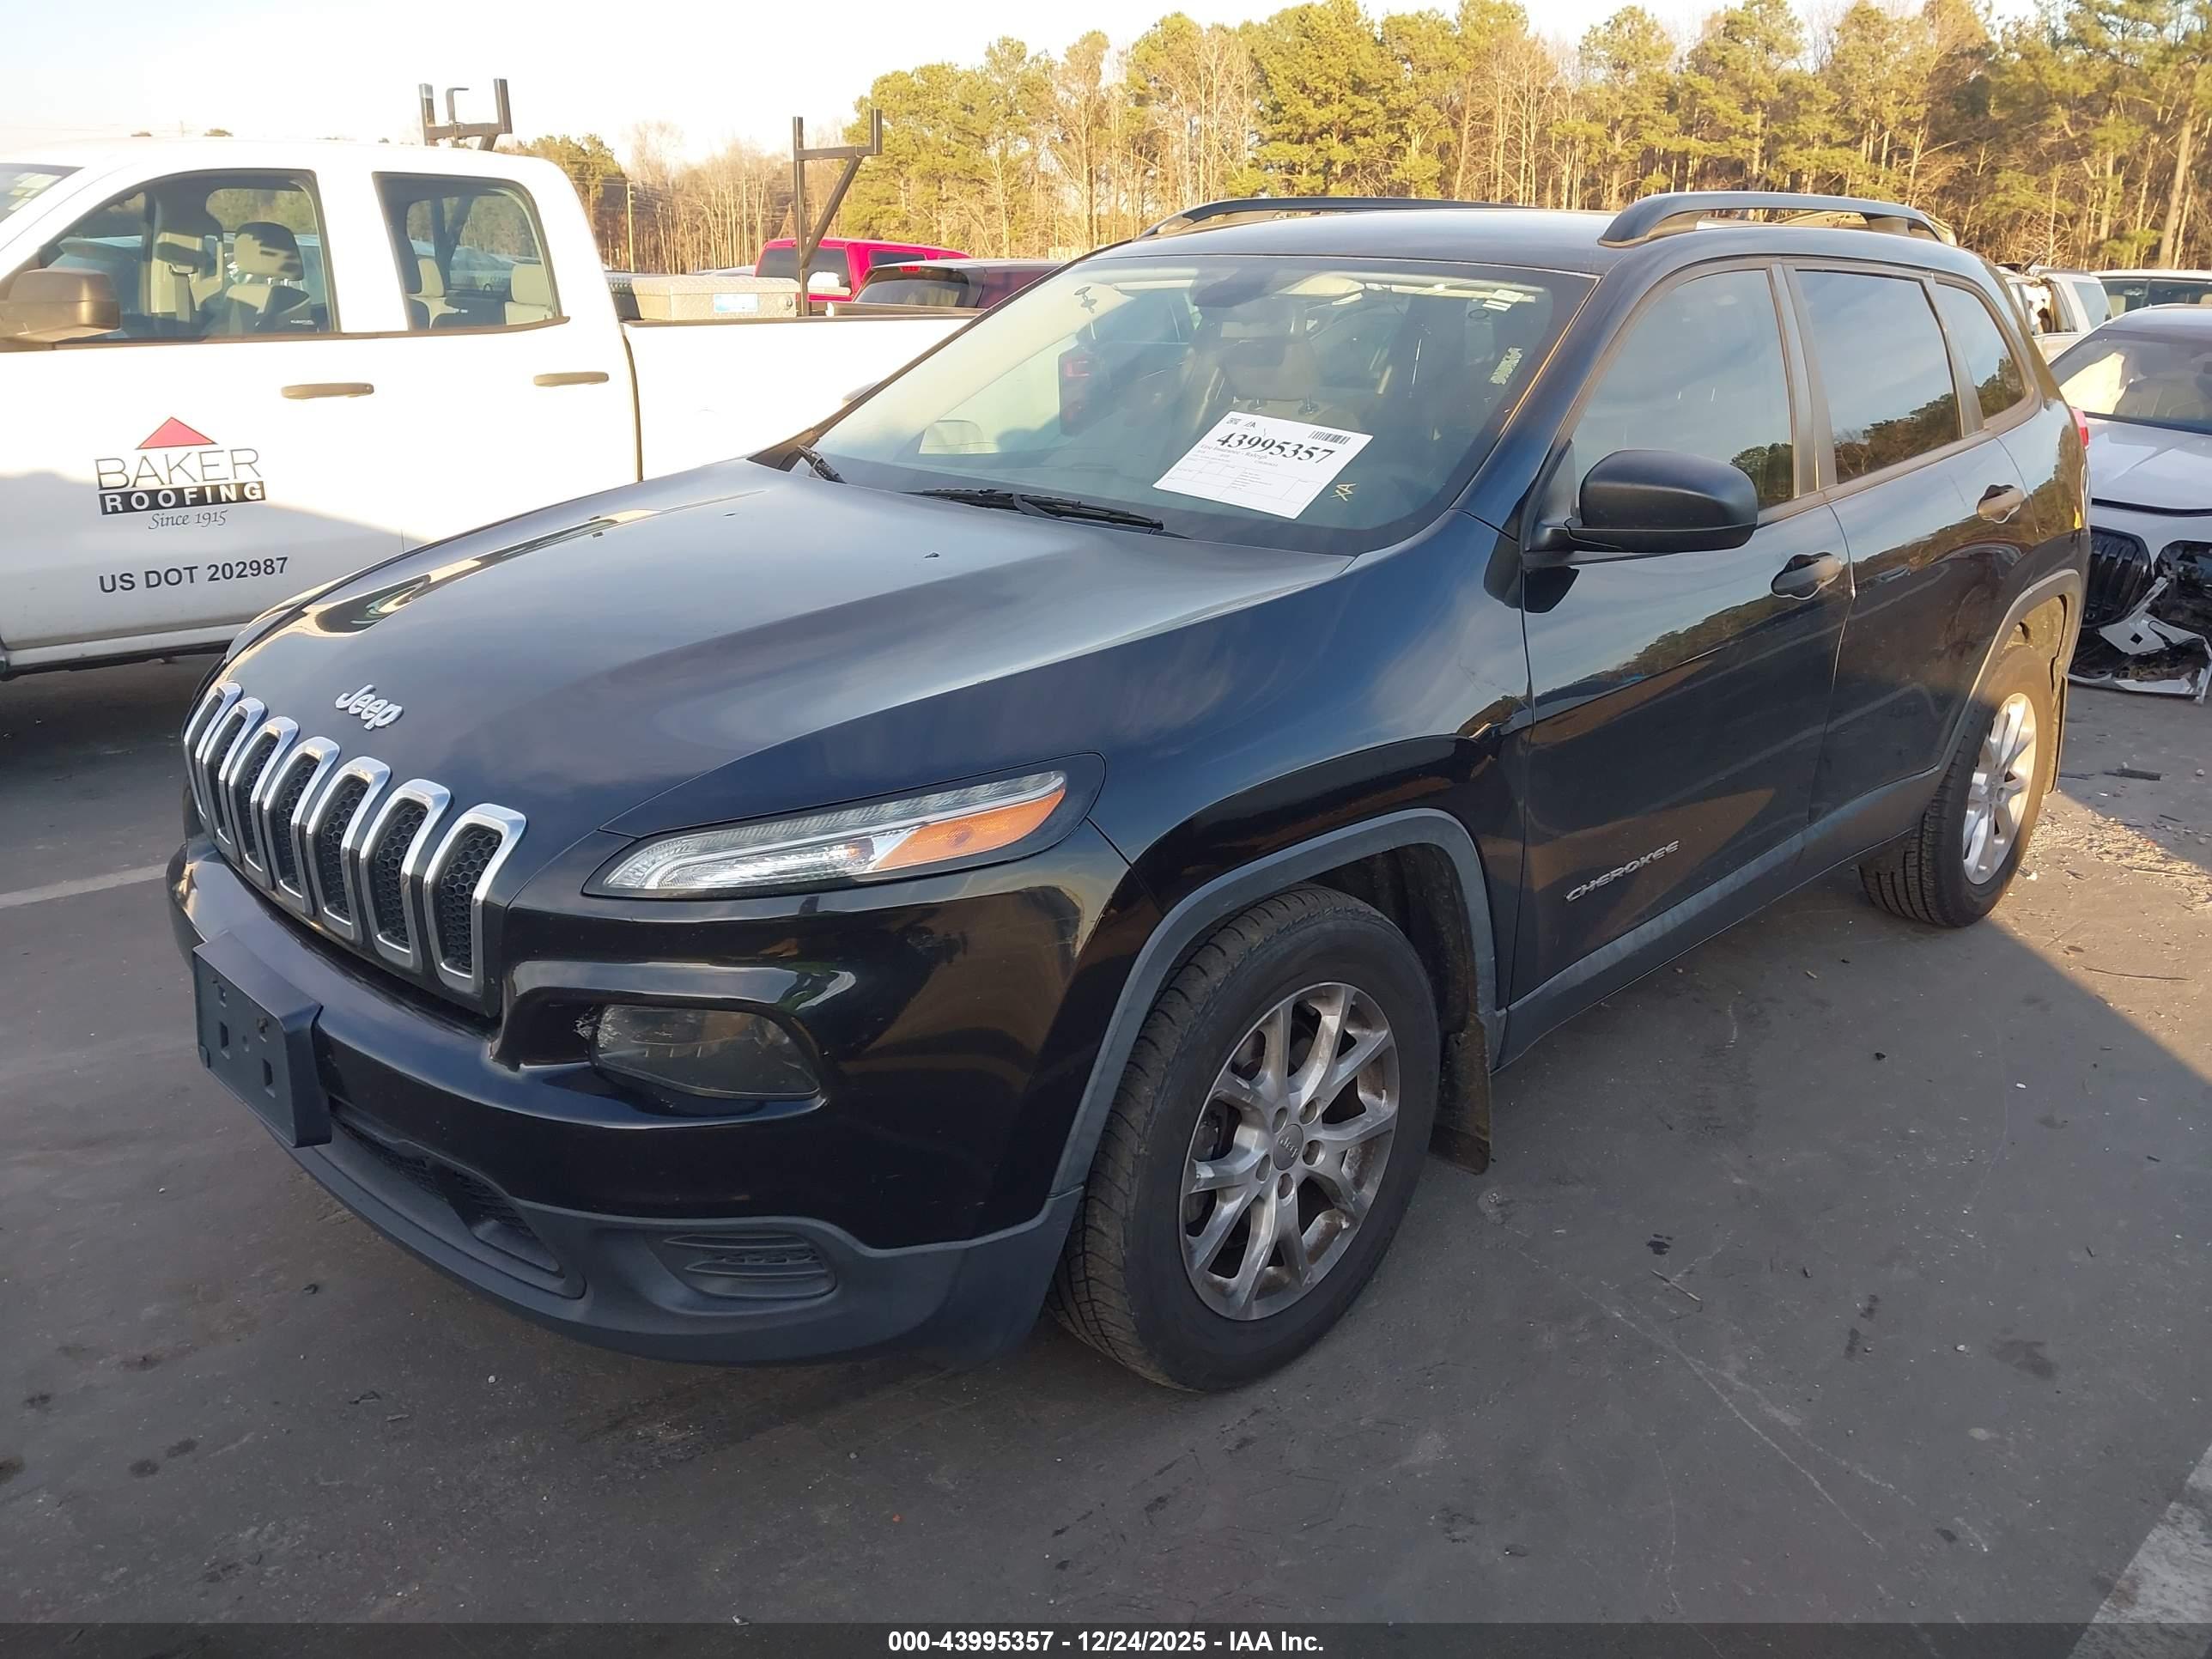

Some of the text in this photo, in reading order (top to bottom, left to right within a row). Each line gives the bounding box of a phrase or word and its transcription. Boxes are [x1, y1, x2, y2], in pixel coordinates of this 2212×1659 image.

[1216, 432, 1335, 464] 43995357
[94, 448, 261, 490] BAKER
[104, 482, 263, 513] ROOFING
[148, 509, 228, 530] Since 1915
[98, 556, 289, 593] US DOT 202987
[335, 684, 404, 730] Jeep
[1565, 840, 1680, 902] CHEROKEE
